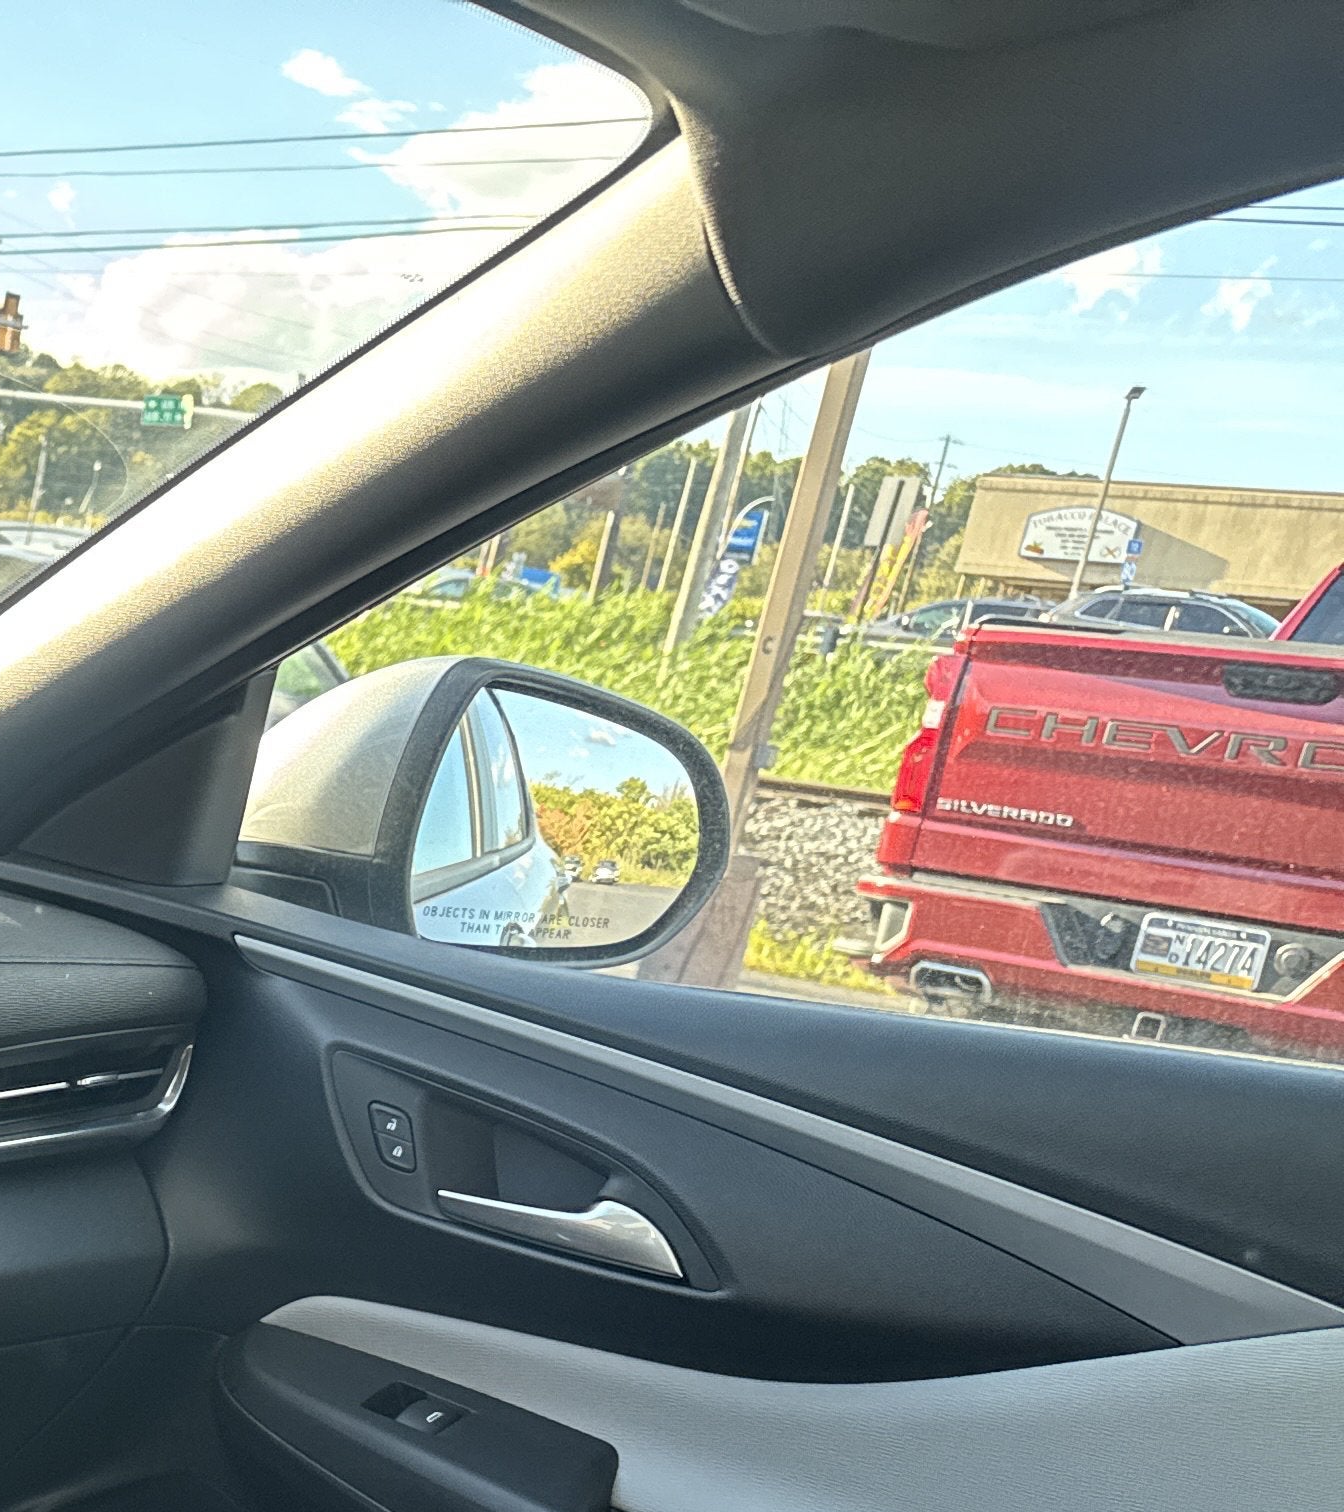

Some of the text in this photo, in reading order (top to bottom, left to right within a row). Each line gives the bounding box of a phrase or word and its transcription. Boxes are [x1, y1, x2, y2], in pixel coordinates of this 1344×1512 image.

[936, 797, 1075, 828] SILVERADO
[422, 905, 611, 929] OBJECTS IN MIRROR ARE CLOSER
[460, 921, 490, 934] THAN
